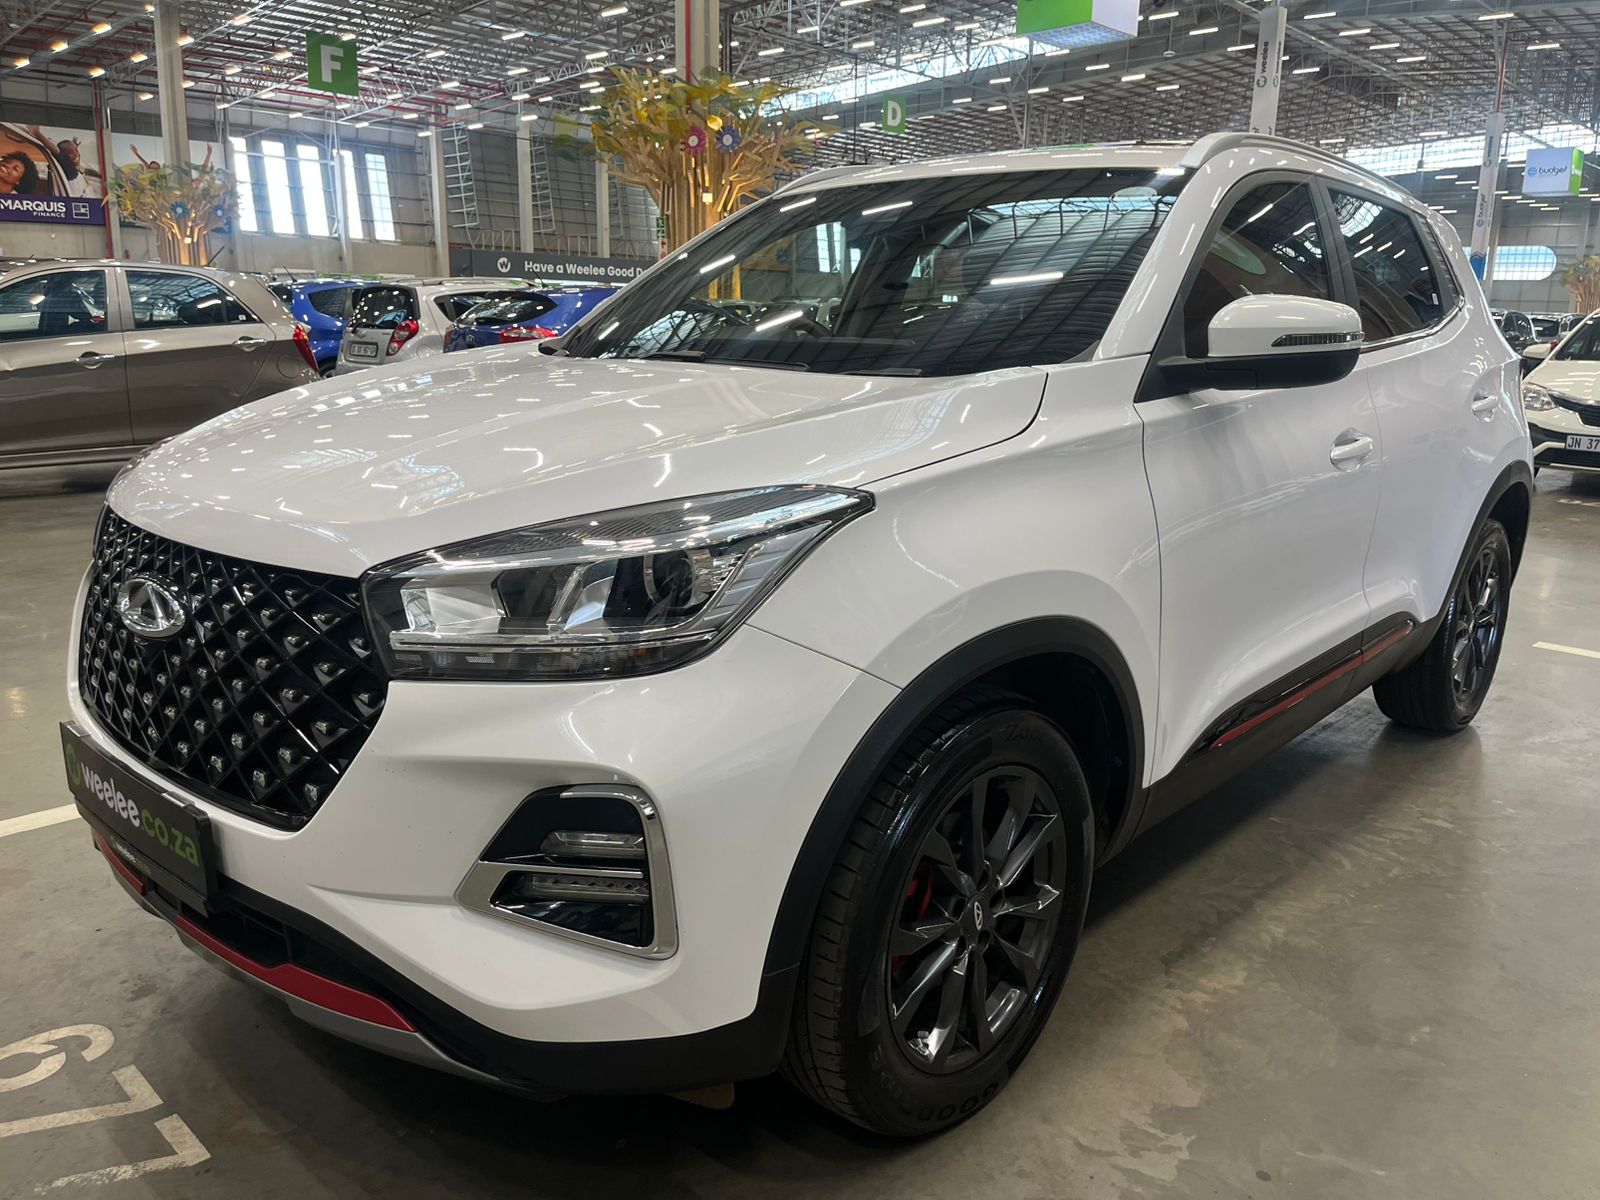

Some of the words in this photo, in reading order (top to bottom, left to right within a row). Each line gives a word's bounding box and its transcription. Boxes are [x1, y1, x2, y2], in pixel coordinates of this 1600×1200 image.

[320, 44, 345, 83] F
[887, 100, 902, 127] D
[1538, 166, 1568, 176] budget
[0, 198, 67, 213] MARQUIS
[524, 260, 555, 273] Have
[556, 264, 564, 274] a
[565, 263, 606, 276] Weelee
[607, 266, 635, 278] Good
[1567, 437, 1581, 448] JN
[80, 761, 200, 867] weelee.co.za
